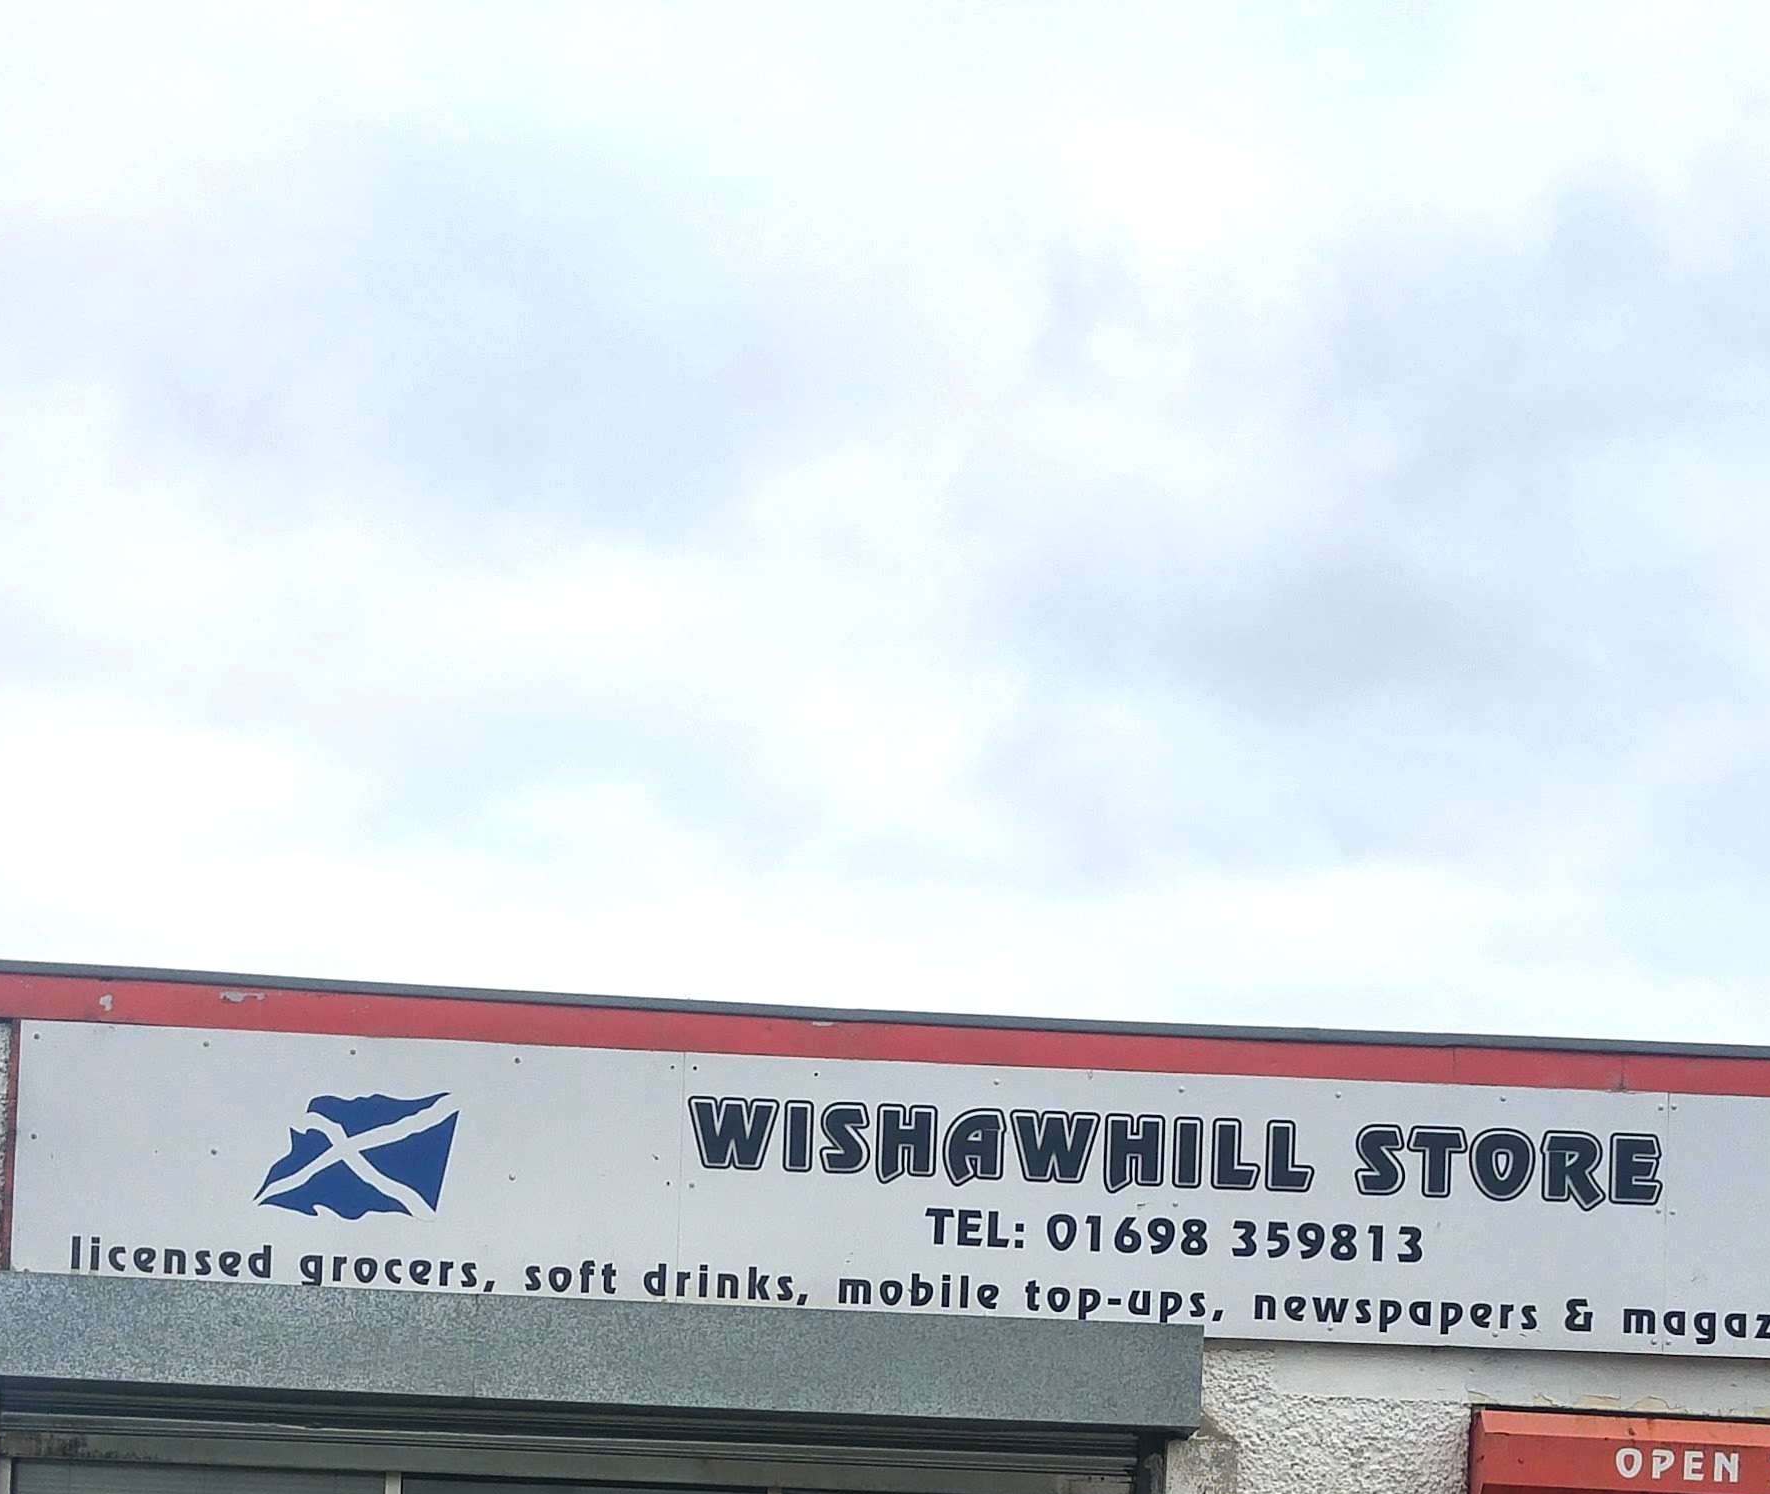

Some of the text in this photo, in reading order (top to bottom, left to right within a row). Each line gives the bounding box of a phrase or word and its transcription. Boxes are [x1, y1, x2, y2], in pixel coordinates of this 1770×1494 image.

[688, 1096, 1664, 1212] WISHAWHILL STORE
[924, 1207, 1425, 1263] TEL: 01698 359813
[70, 1235, 273, 1279] licensed
[299, 1252, 496, 1293] grocers,
[525, 1259, 618, 1294] soft
[643, 1263, 808, 1306] drinks,
[837, 1273, 1000, 1310] mobile
[1024, 1280, 1225, 1323] top-ups,
[1253, 1293, 1539, 1336] newspapers
[1564, 1298, 1594, 1334] &
[1614, 1446, 1740, 1485] OPEN
